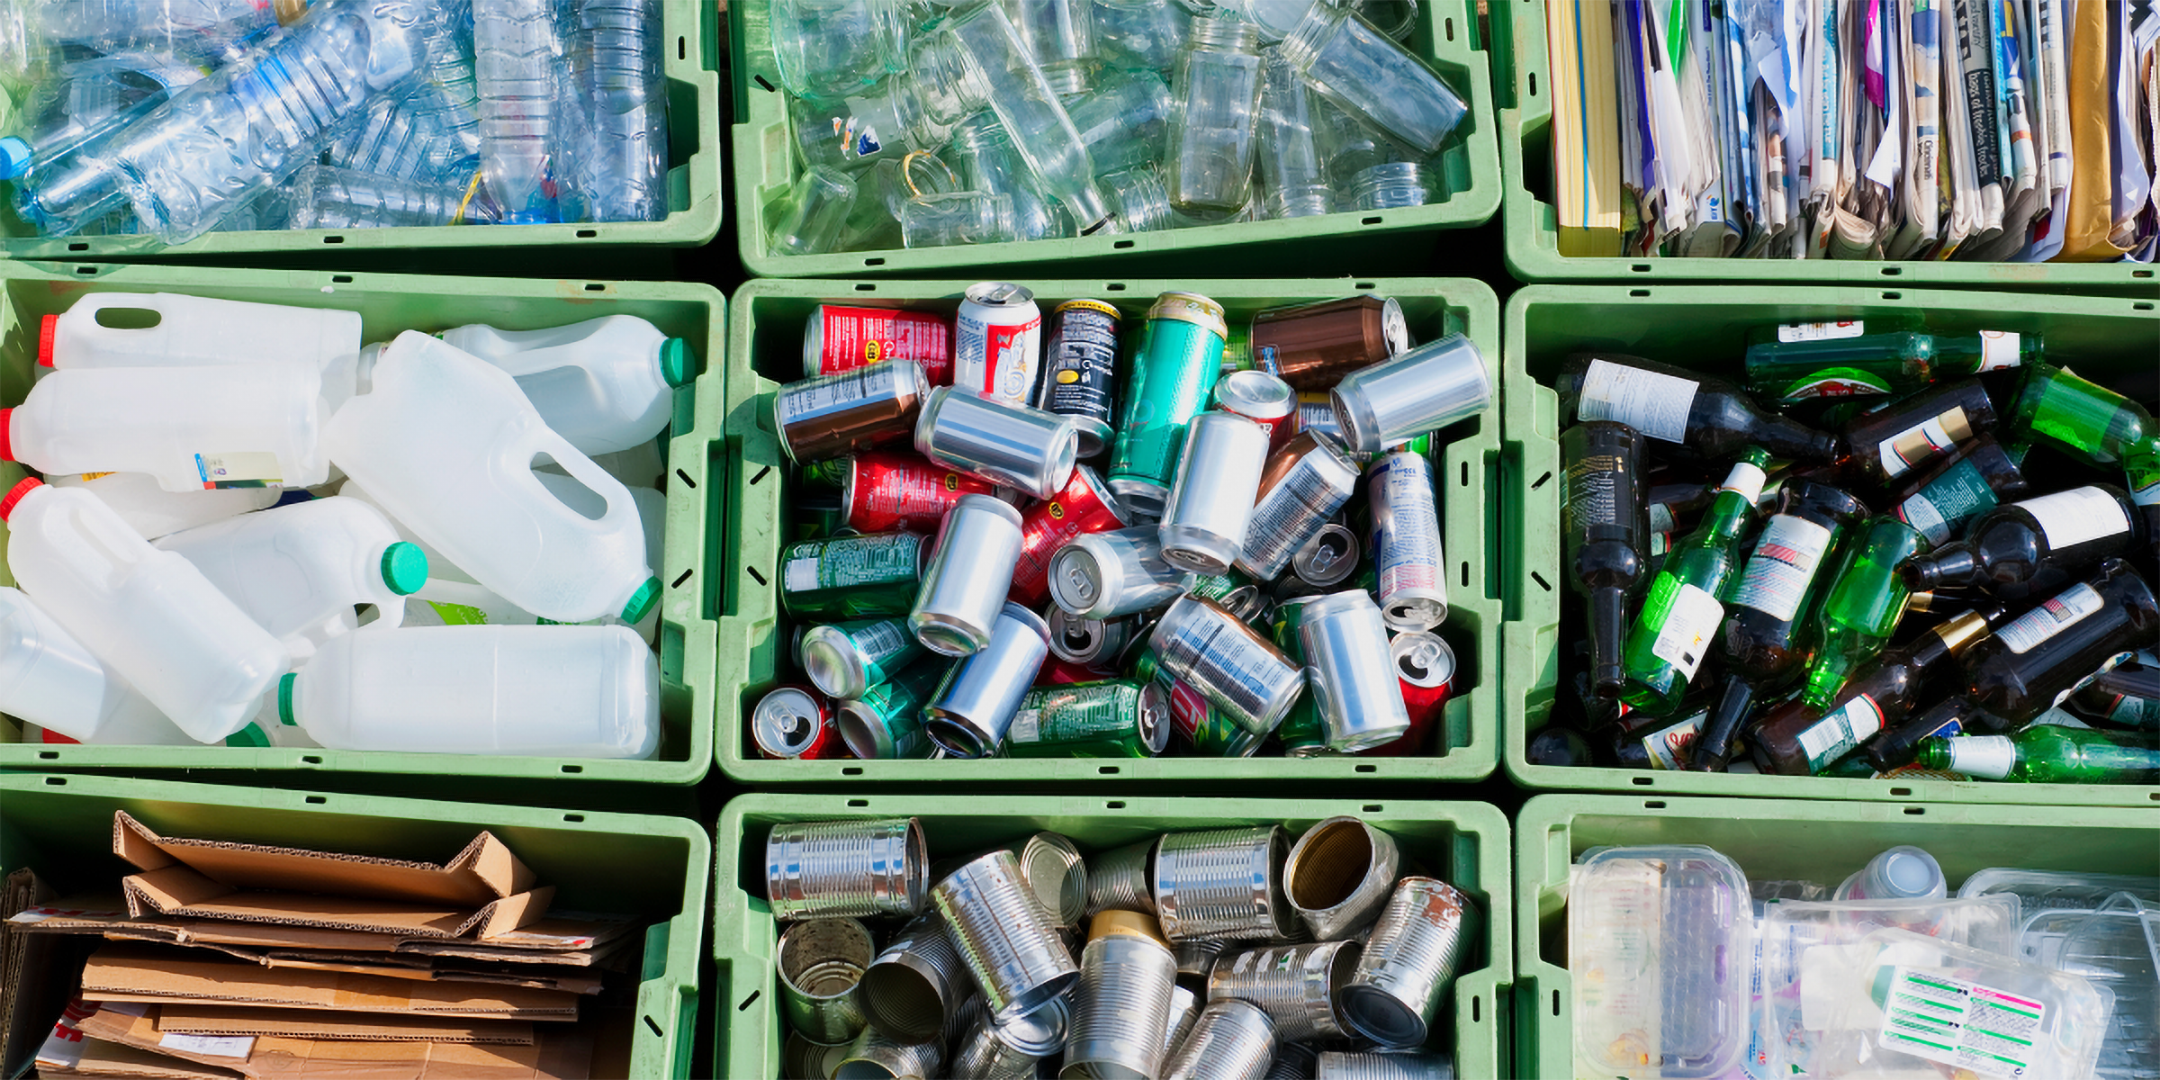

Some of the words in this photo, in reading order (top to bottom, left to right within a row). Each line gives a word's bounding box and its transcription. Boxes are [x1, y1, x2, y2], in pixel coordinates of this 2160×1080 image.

[1969, 72, 1981, 98] bags
[1971, 98, 1984, 109] of
[1972, 110, 1987, 146] freebie
[1978, 146, 1990, 178] frocks
